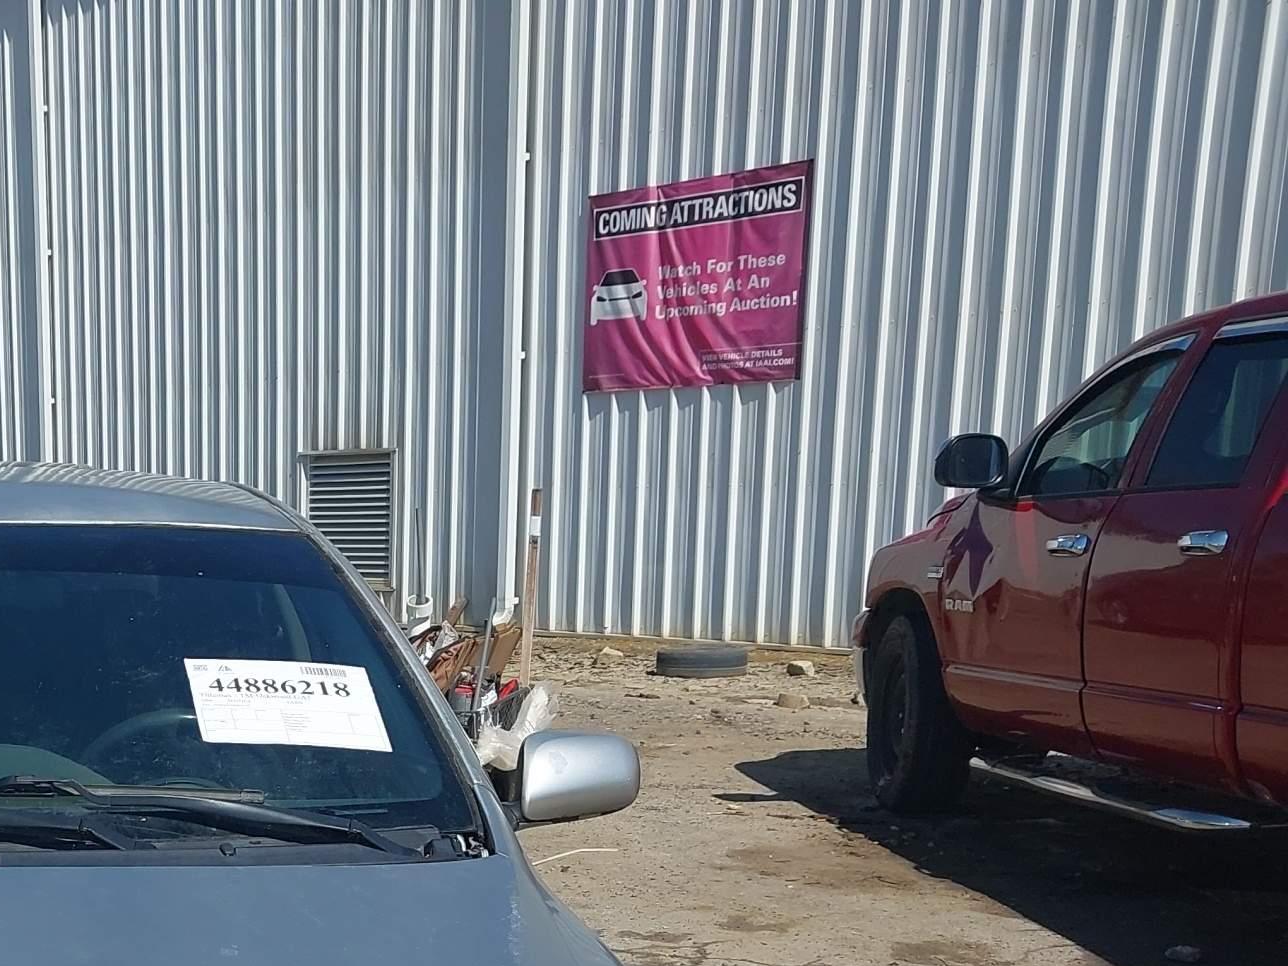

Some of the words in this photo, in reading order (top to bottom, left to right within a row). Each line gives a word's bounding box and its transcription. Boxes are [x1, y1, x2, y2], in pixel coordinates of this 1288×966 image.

[598, 204, 667, 235] COMING
[670, 183, 797, 225] ATTRACTIONS
[658, 258, 701, 279] Watch
[707, 258, 733, 275] For
[737, 253, 786, 270] These
[656, 281, 718, 300] Vehicles
[723, 276, 742, 292] At
[747, 274, 770, 289] An
[655, 300, 726, 320] Upcoming
[729, 290, 798, 313] Auction!
[719, 351, 749, 360] VEHICLE
[751, 349, 783, 358] DETAILS
[945, 598, 974, 612] RAM
[209, 677, 351, 697] 44886218
